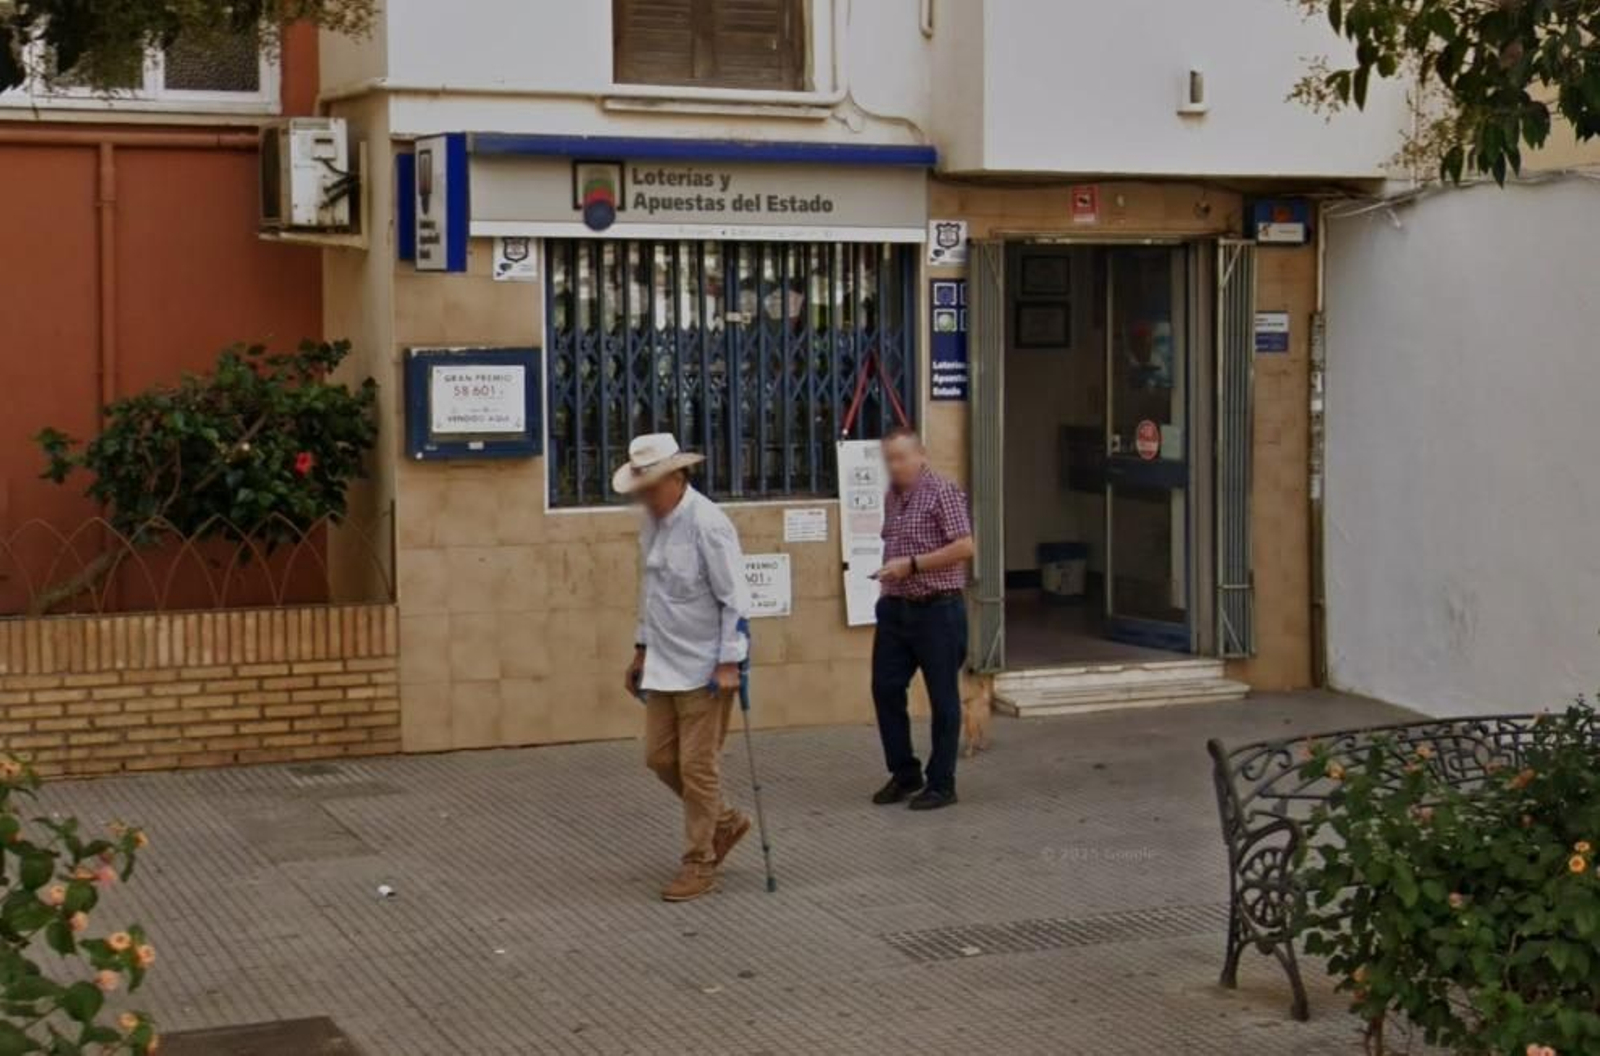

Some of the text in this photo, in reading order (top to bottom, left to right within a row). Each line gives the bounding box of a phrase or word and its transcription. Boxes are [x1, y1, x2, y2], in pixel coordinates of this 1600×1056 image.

[632, 167, 731, 192] Loterías y
[633, 192, 834, 214] Apuestas del Estado
